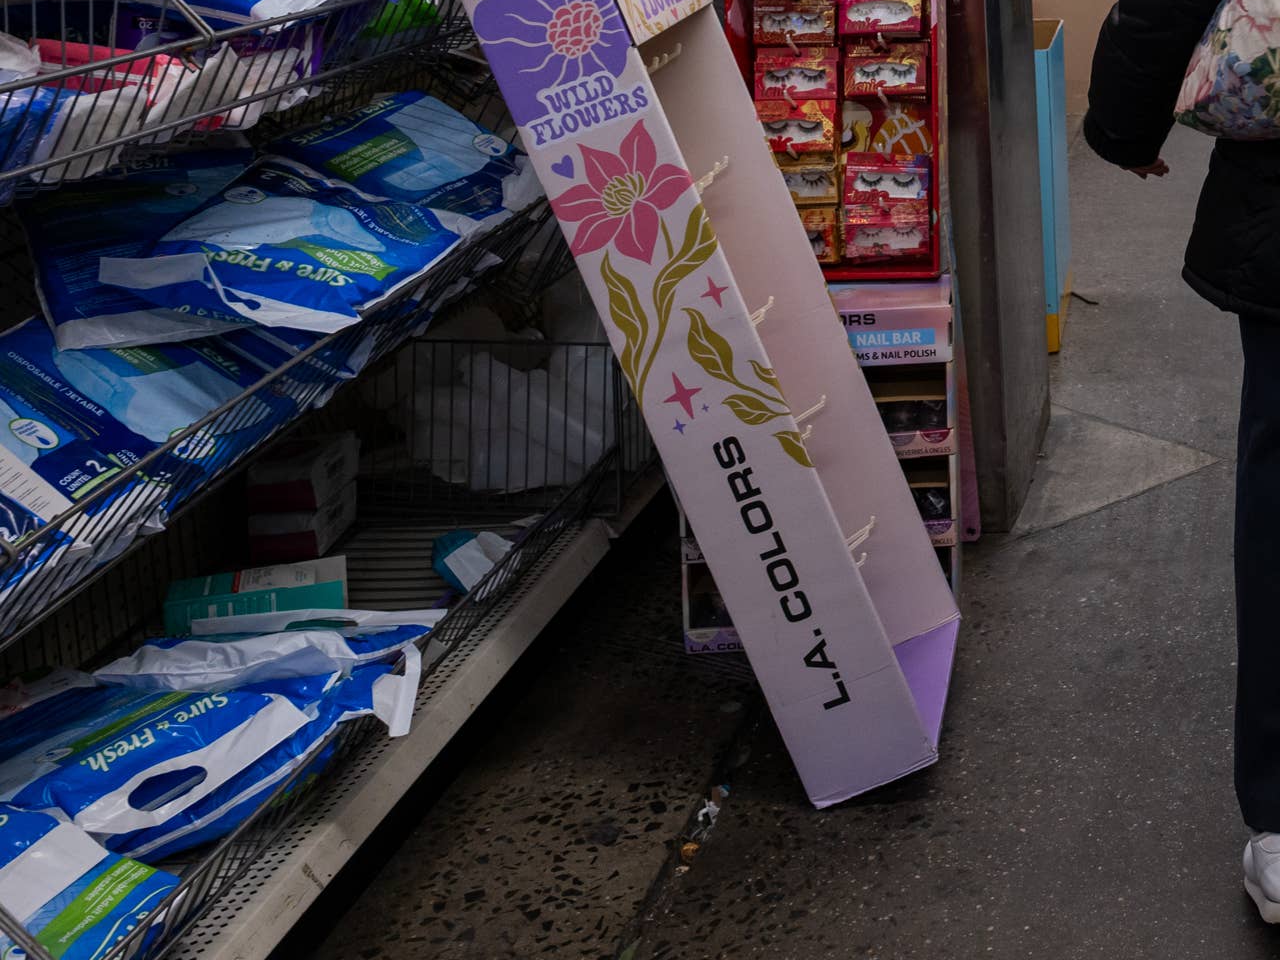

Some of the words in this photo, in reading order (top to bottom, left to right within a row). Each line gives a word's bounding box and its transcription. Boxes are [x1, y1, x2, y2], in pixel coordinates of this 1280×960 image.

[545, 74, 615, 114] WILD
[529, 85, 649, 146] FLOWERS
[299, 263, 356, 288] Sure
[856, 333, 889, 347] NAIL
[892, 330, 921, 345] BAR
[871, 351, 880, 361] &
[880, 350, 902, 360] NAIL
[903, 348, 937, 359] POLISH
[7, 351, 61, 390] DISPOSABLE
[64, 390, 105, 417] JETABLE
[86, 459, 108, 473] 2
[711, 435, 813, 624] COLORS
[802, 627, 851, 711] L.A.
[174, 692, 229, 724] Sure
